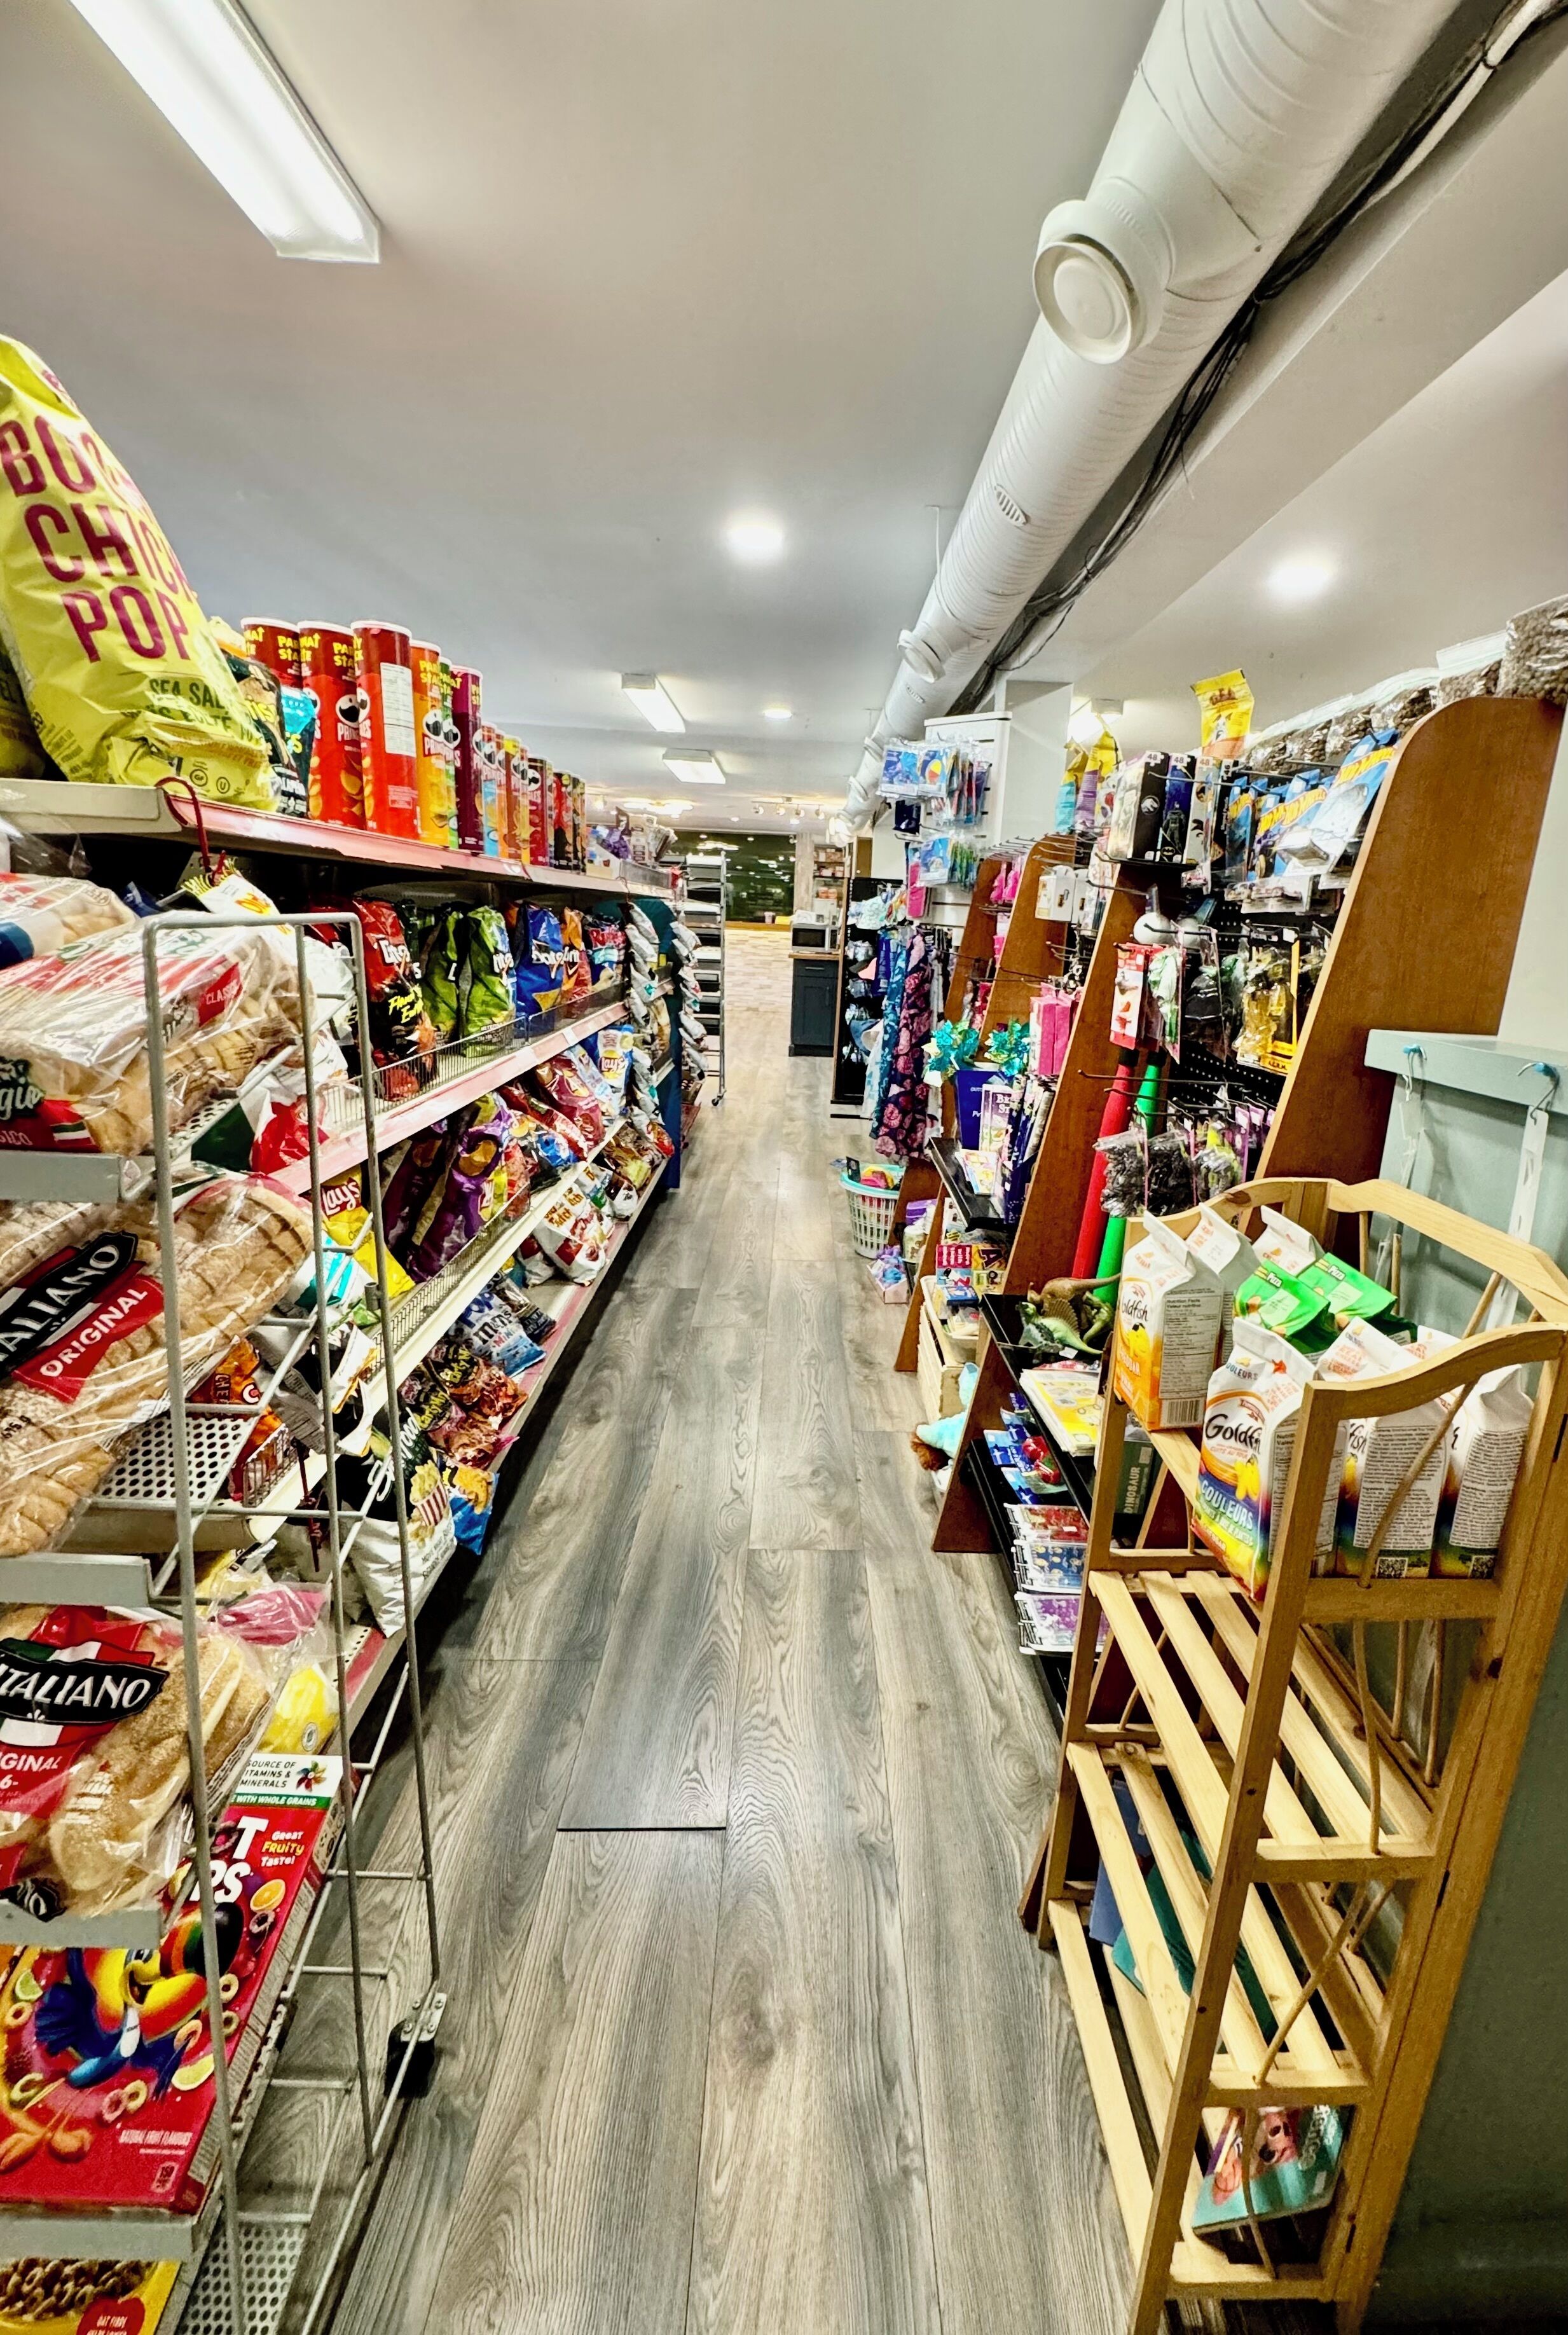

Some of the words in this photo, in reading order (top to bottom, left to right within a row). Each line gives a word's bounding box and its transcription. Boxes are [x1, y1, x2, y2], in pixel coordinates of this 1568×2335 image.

[62, 585, 190, 663] POP
[189, 682, 225, 710] SAL
[0, 1244, 120, 1362] ALIANO
[1120, 1295, 1150, 1323] oldfish
[39, 1288, 148, 1377] ORIGINAL
[1225, 1361, 1259, 1381] OULEURS
[1124, 1466, 1141, 1514] DINOSAUR
[1202, 1479, 1254, 1531] COULEURS
[239, 1779, 287, 1789] MINERALS
[285, 1770, 291, 1779] &
[236, 1795, 257, 1803] WITH
[258, 1796, 286, 1805] WHOLE
[285, 1797, 318, 1806] GRAINS
